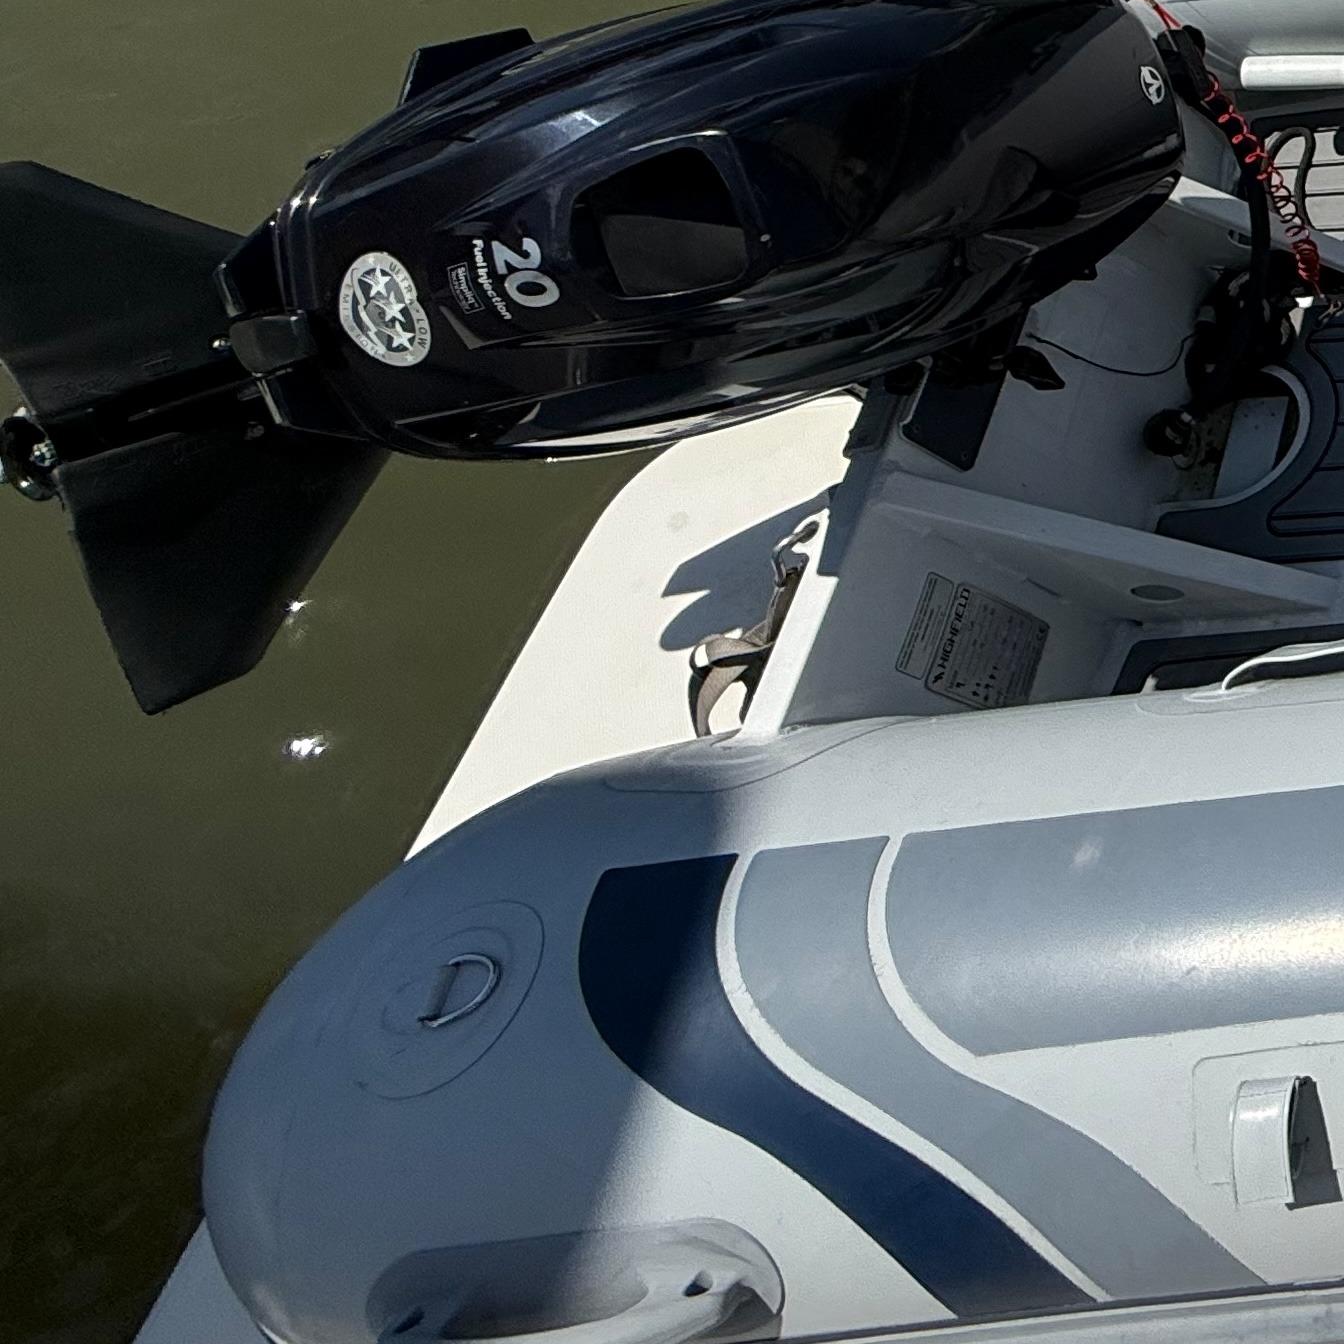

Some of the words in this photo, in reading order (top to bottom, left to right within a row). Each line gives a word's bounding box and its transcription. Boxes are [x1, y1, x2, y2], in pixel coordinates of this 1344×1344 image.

[472, 239, 488, 267] Fuel
[491, 237, 560, 308] 20
[478, 268, 513, 320] Injection
[416, 318, 428, 349] LOW
[938, 587, 971, 670] HIGHFIELD
